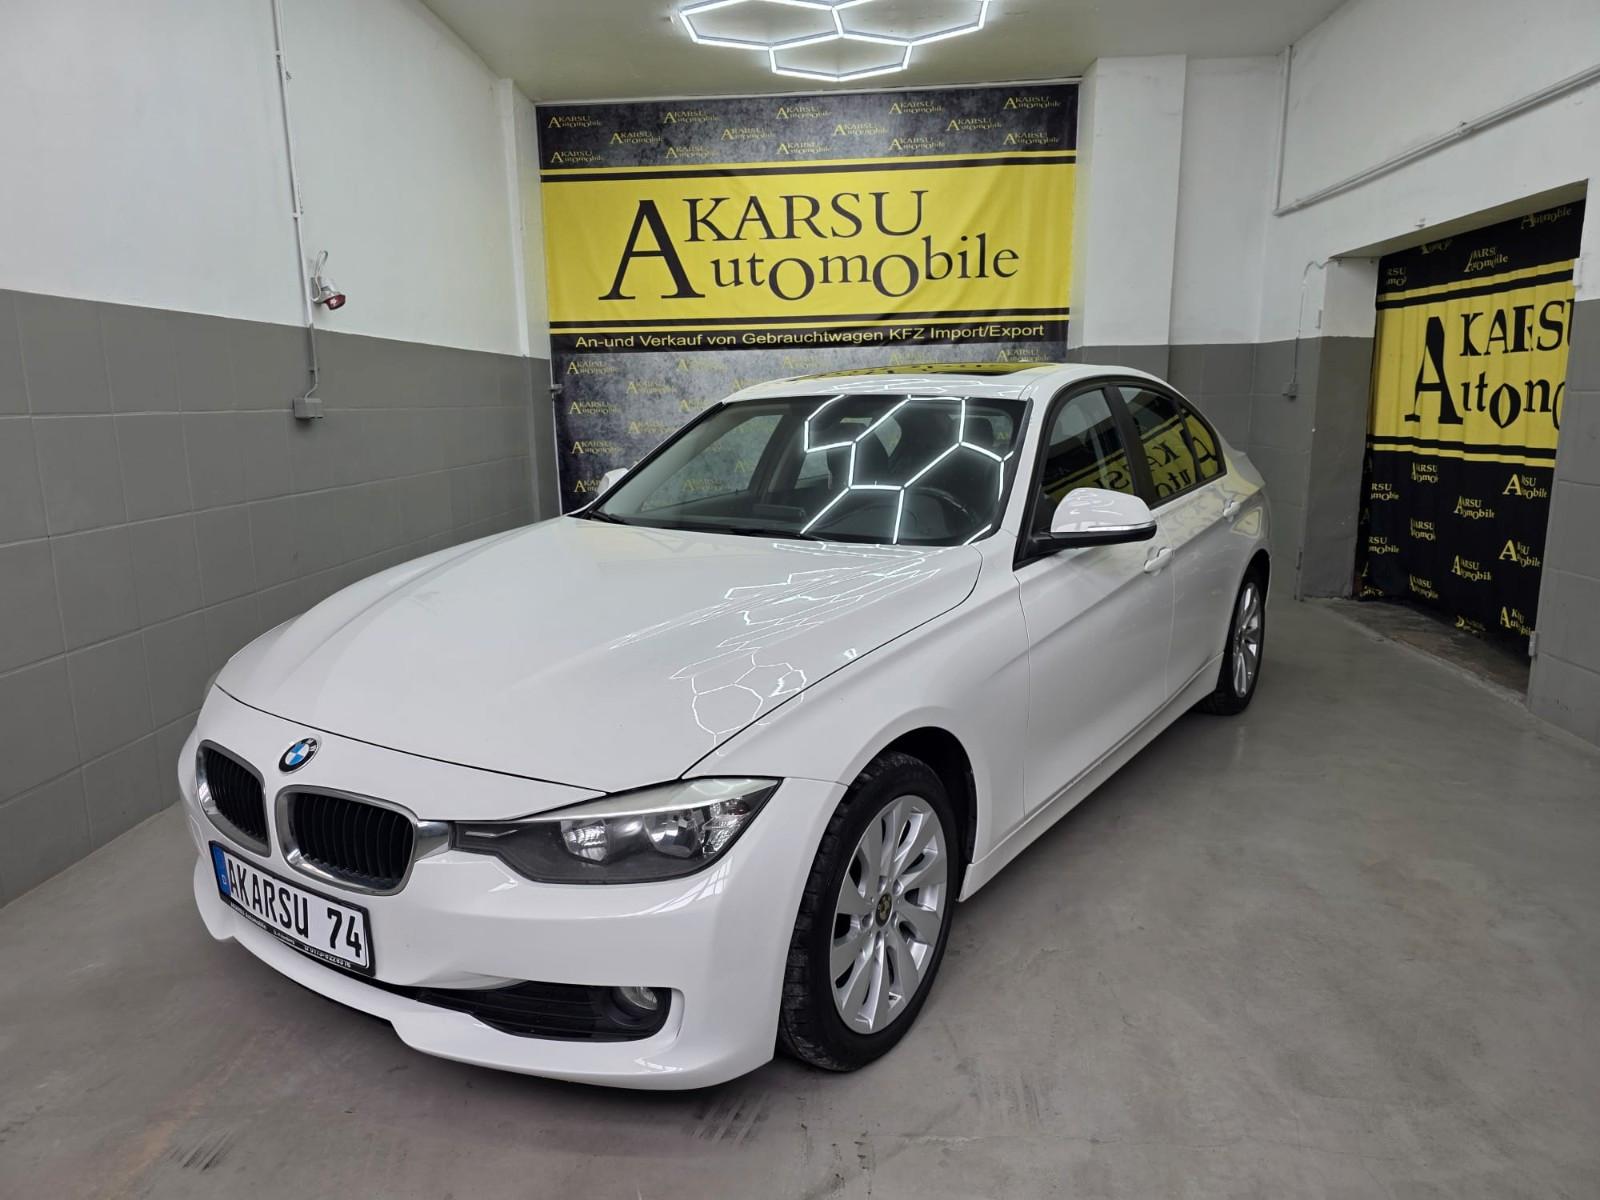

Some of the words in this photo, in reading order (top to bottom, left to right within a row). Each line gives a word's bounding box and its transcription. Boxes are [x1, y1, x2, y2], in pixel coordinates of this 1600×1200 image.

[598, 190, 928, 300] AKARSU
[576, 336, 634, 348] An-und
[639, 335, 701, 347] Verkauf
[707, 336, 736, 345] von
[742, 328, 883, 345] Gebrauchtwagen
[889, 328, 924, 340] KFZ
[930, 325, 1045, 340] Import/Export
[228, 859, 308, 938] AKARSU
[327, 907, 362, 958] 74
